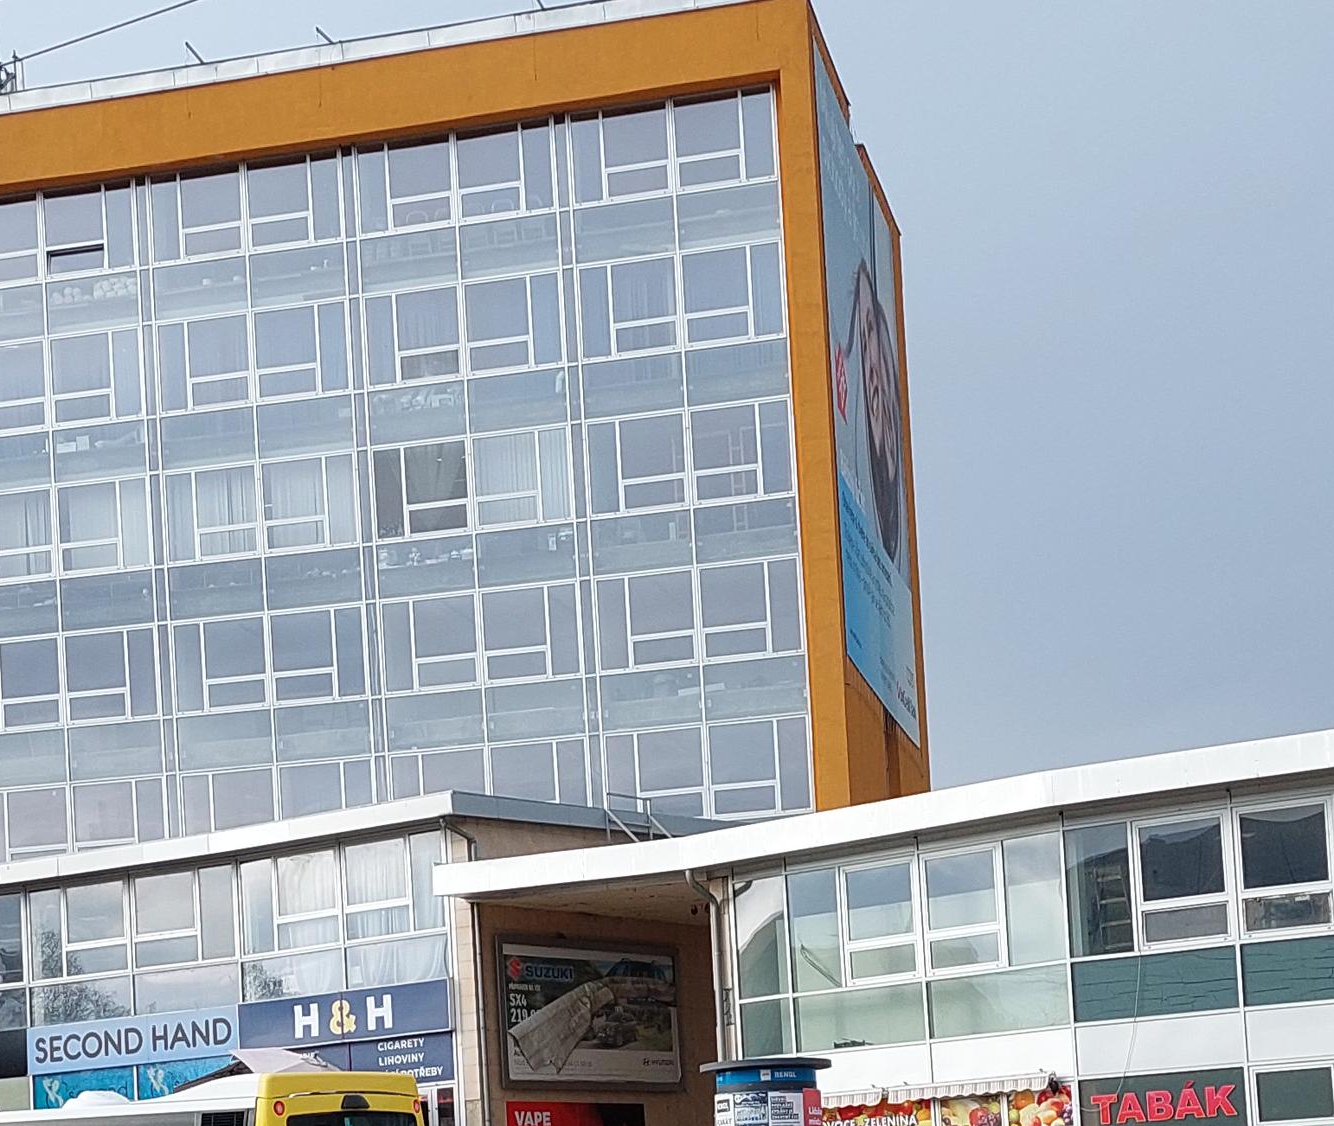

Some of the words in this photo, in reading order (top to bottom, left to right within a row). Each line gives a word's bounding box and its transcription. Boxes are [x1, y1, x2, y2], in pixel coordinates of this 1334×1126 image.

[525, 965, 573, 980] SUZUKI
[509, 993, 527, 1007] SX4
[294, 1003, 319, 1039] H
[329, 1000, 357, 1035] &
[366, 994, 394, 1031] H
[34, 1027, 143, 1064] SECOND
[151, 1017, 232, 1052] HAND
[378, 1037, 425, 1052] CIGARETY
[378, 1052, 425, 1067] LIHOVINY
[1090, 1080, 1238, 1126] TABÁK
[514, 1111, 552, 1126] VAPE
